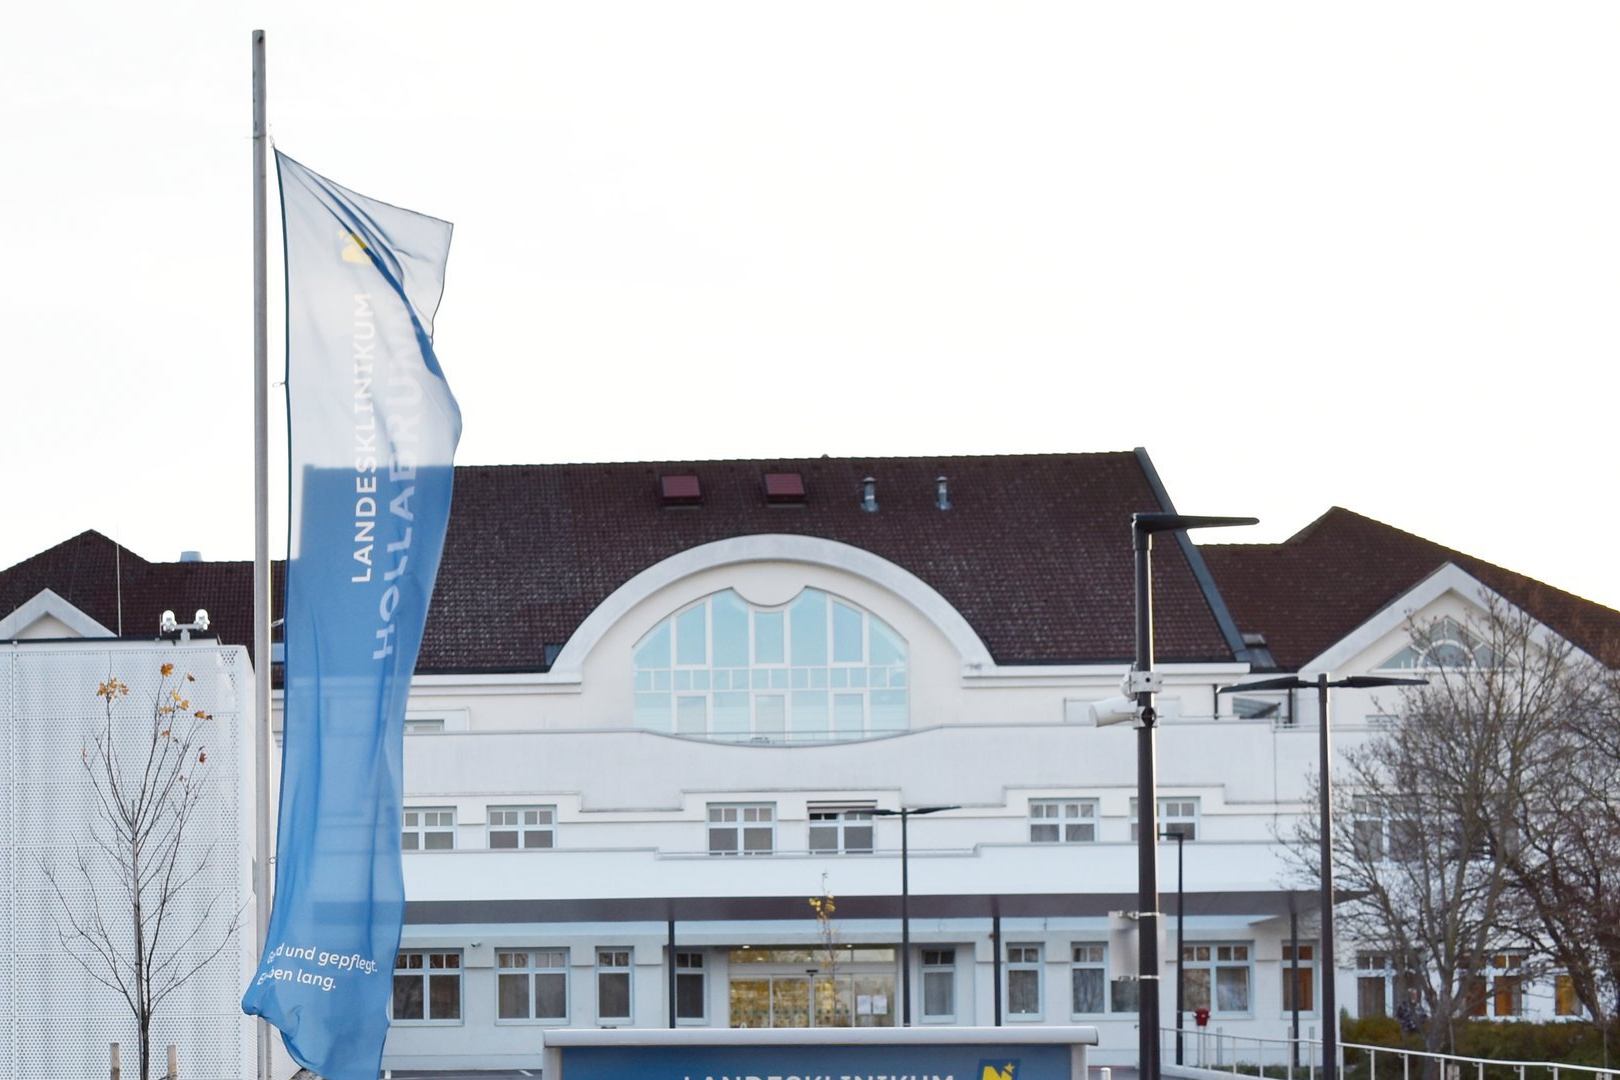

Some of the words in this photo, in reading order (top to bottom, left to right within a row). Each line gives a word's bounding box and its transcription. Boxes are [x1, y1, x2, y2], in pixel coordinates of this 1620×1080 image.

[350, 293, 378, 584] LANDESKLINIKUM
[285, 946, 316, 961] und
[318, 951, 378, 975] gepflegt.
[297, 968, 336, 991] lang.
